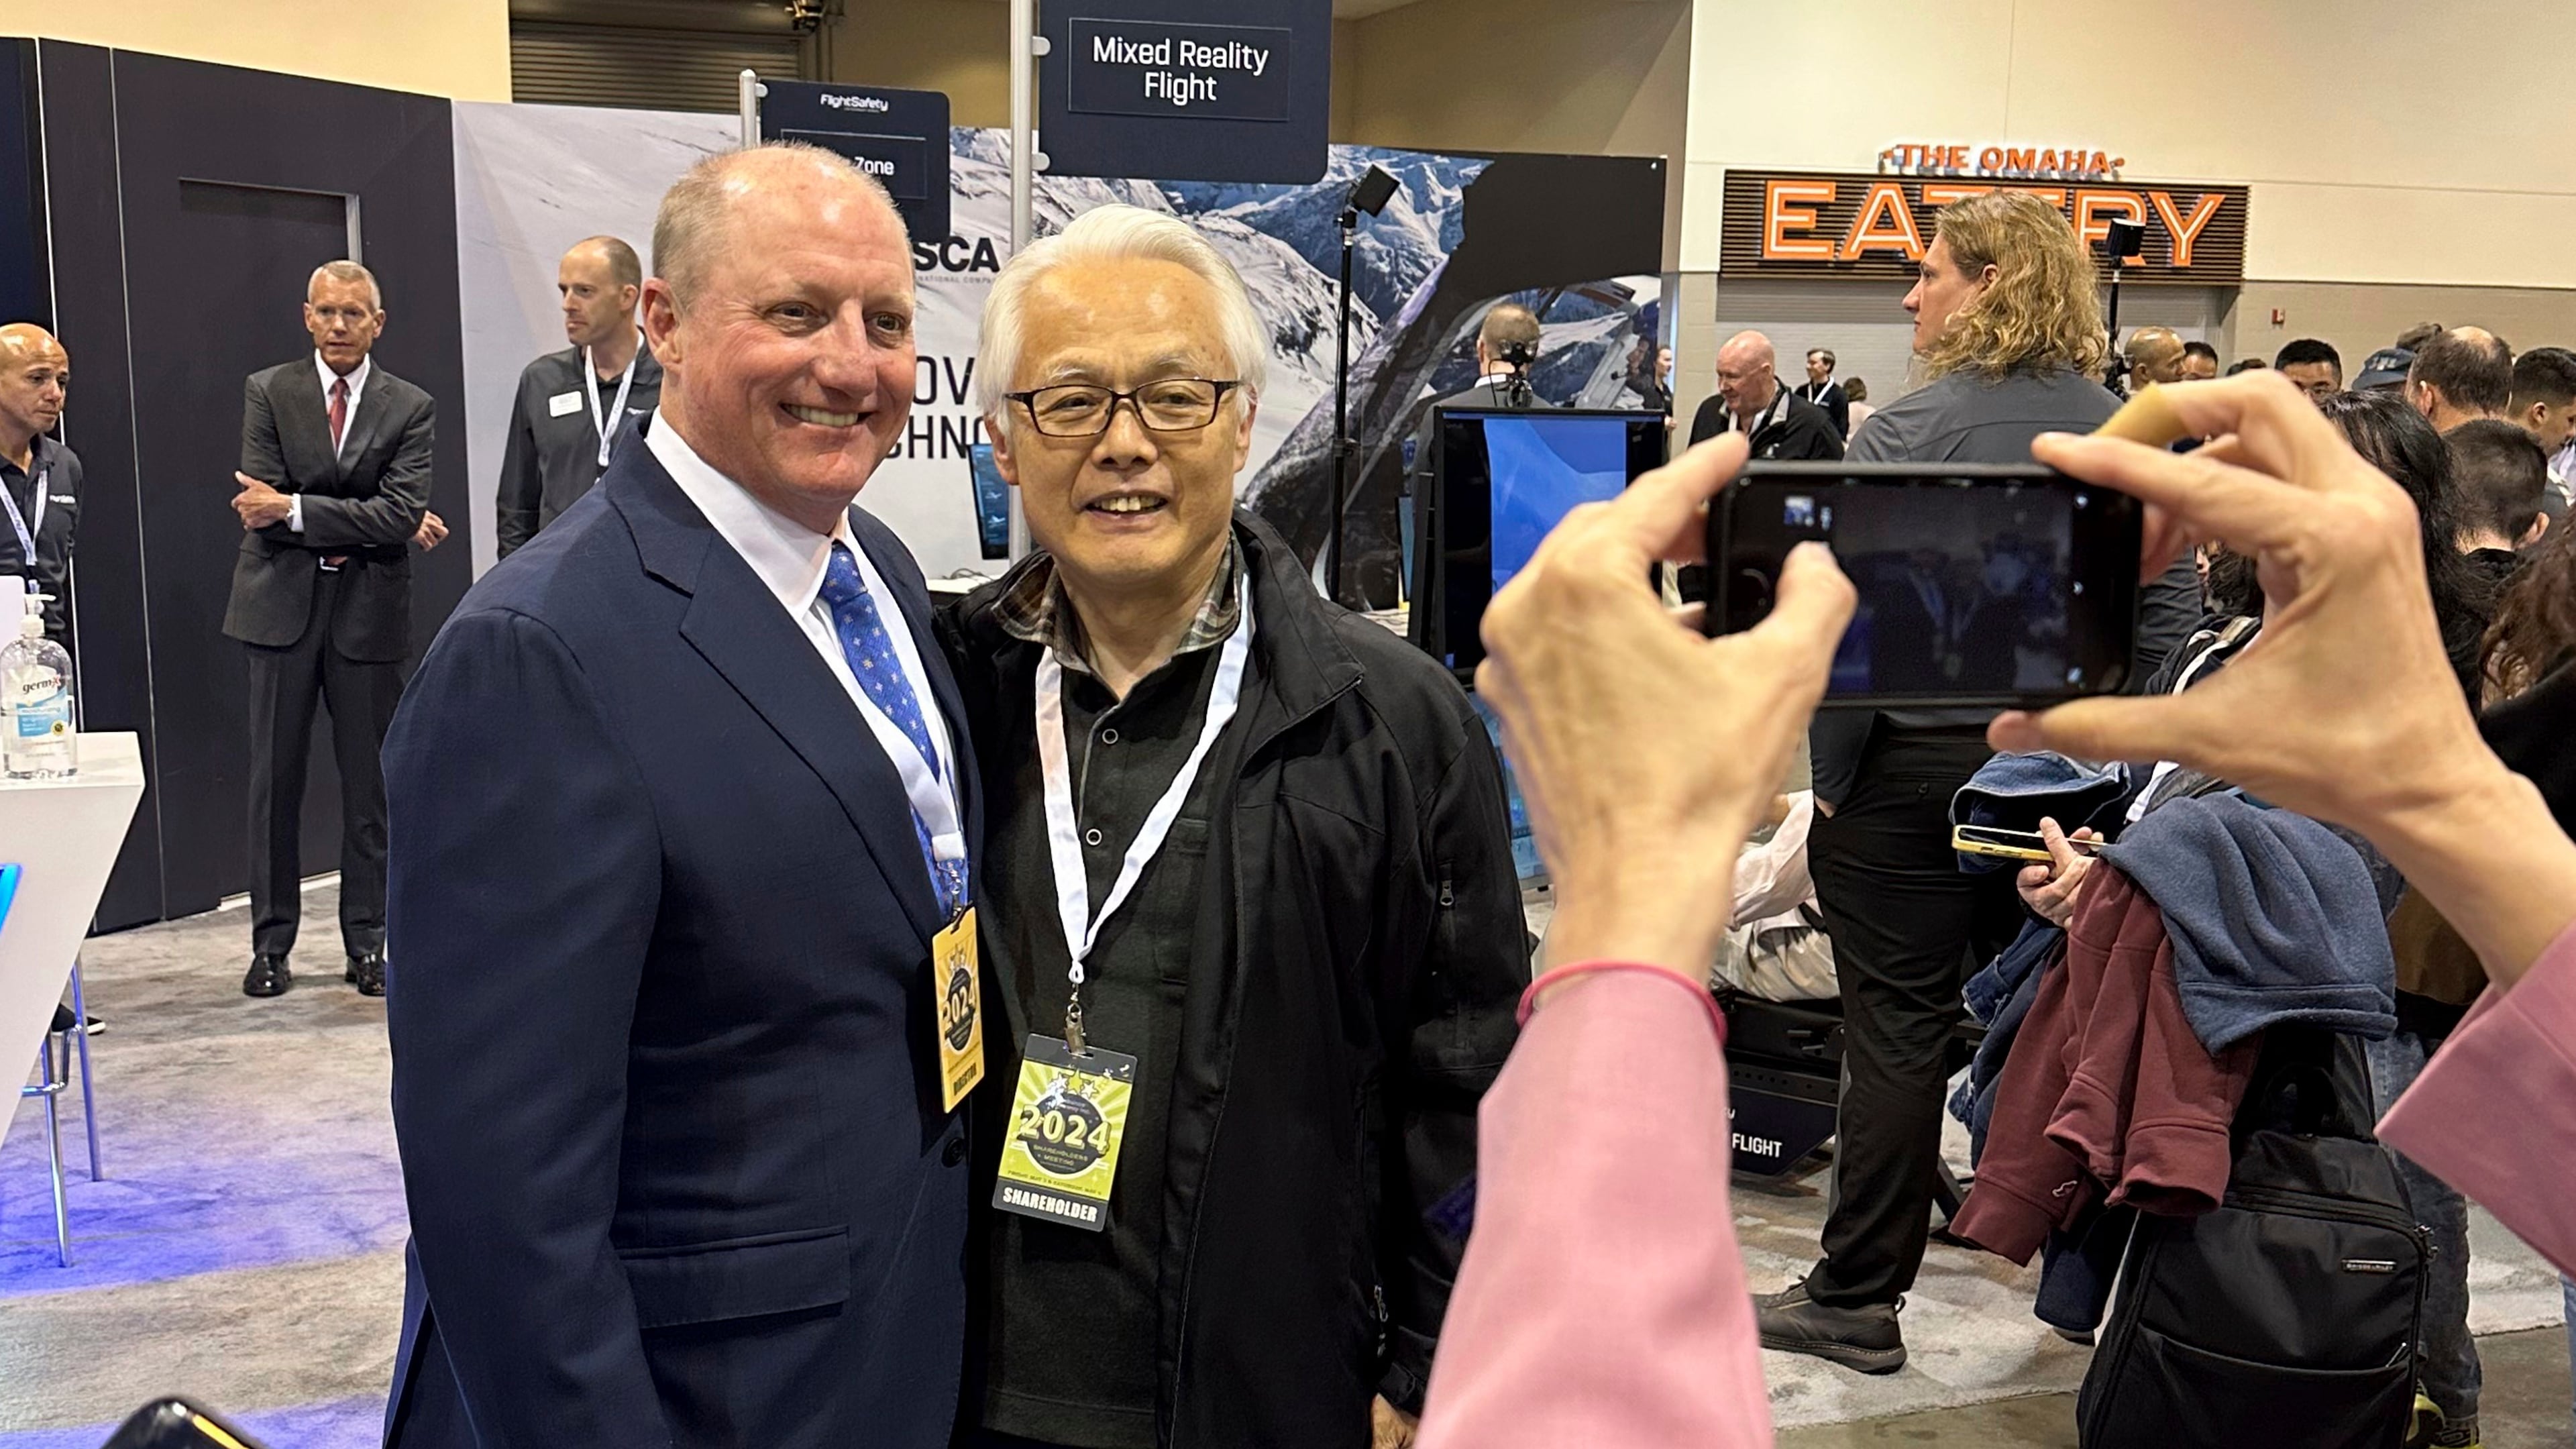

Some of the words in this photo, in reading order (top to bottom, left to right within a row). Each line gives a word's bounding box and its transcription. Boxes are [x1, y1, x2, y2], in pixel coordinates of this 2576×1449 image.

[1093, 36, 1171, 66] Mixed
[1179, 40, 1269, 76] Reality
[820, 94, 889, 112] FlightSafety
[1144, 70, 1218, 106] Flight
[1895, 144, 1970, 168] THE
[1979, 147, 2111, 174] OMAHA
[1764, 180, 2226, 267] EARY
[943, 977, 977, 1034] 2024
[1019, 1104, 1112, 1156] 2024
[1732, 1132, 1782, 1158] FLIGHT
[1002, 1187, 1098, 1223] SHAREHOLDER
